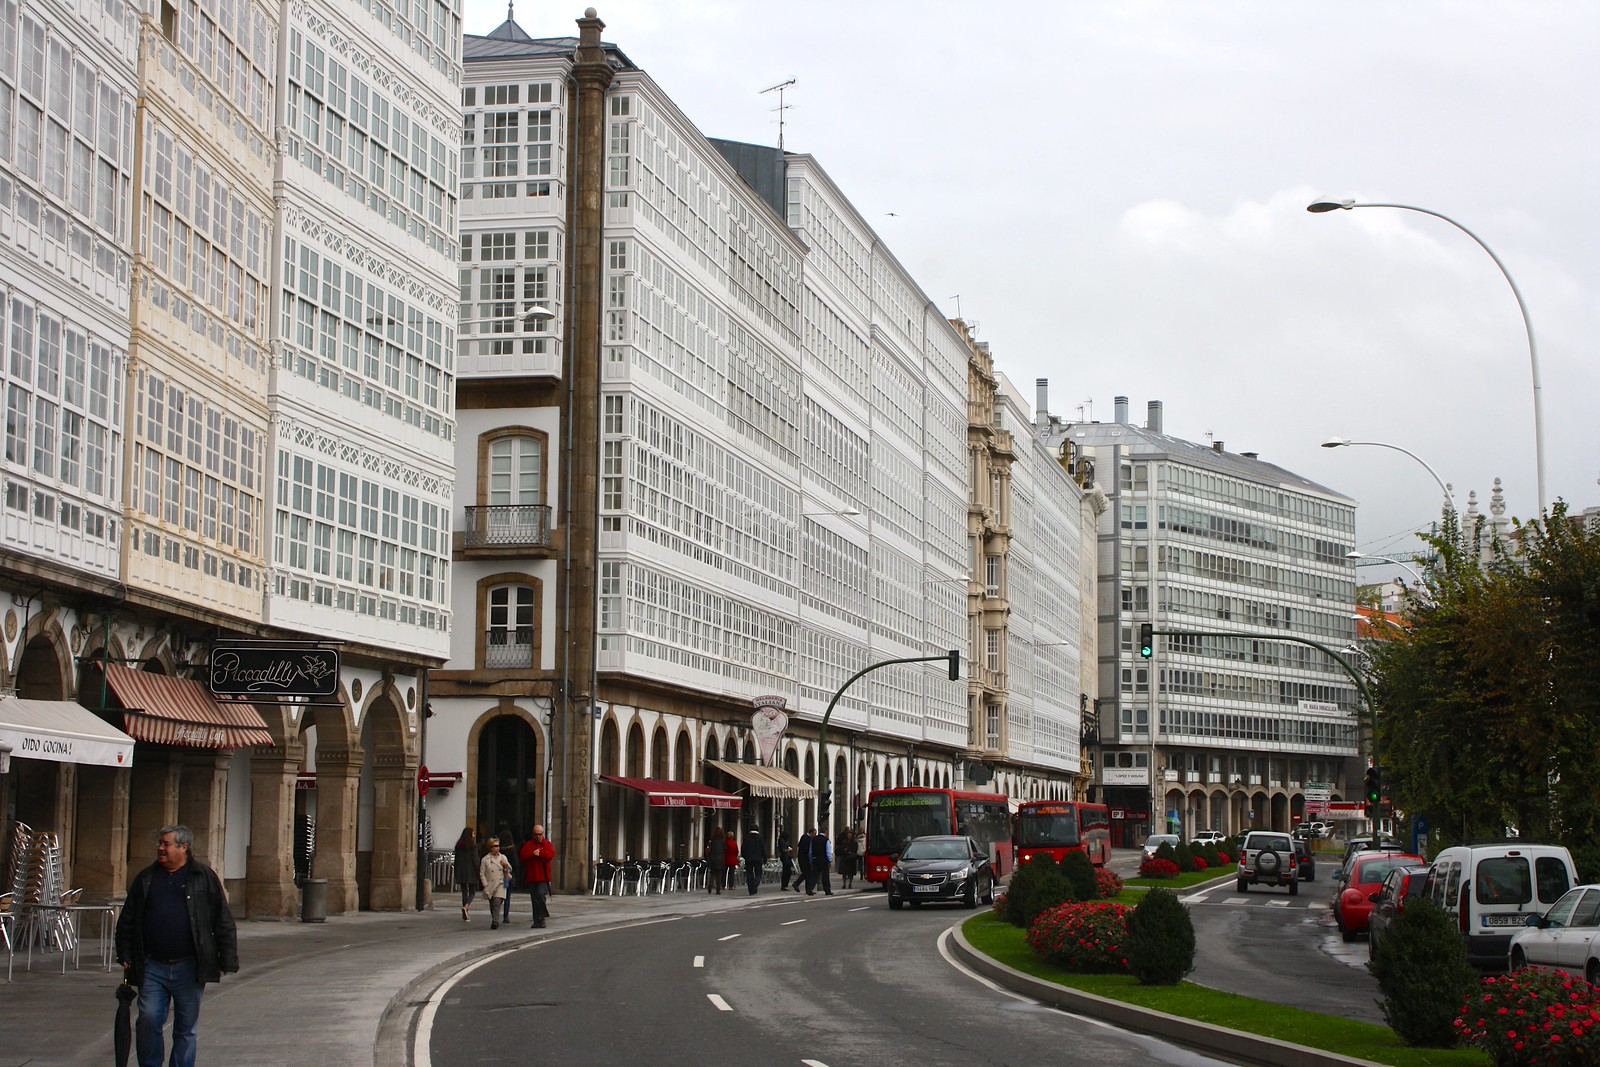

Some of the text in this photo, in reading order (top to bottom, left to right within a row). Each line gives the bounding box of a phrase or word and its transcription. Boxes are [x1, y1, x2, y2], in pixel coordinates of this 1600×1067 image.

[213, 652, 299, 691] Piccadilly
[43, 741, 73, 756] COCINA!
[1489, 916, 1508, 925] 0859
